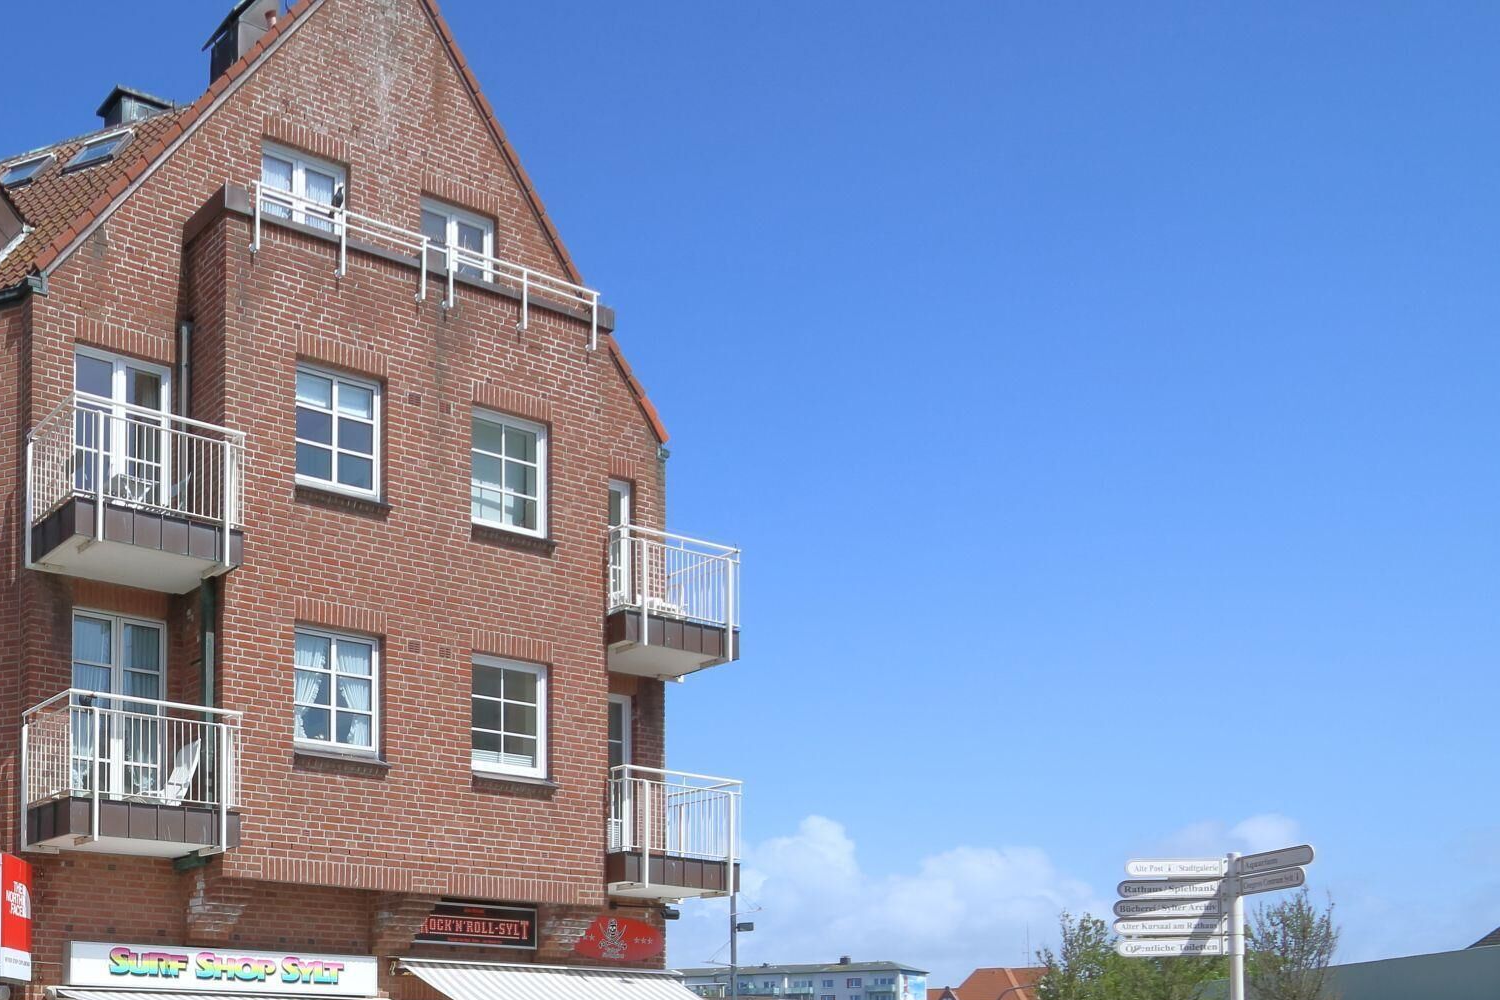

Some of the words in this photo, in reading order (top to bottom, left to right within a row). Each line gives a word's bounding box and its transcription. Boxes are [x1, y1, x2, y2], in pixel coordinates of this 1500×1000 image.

[1133, 864, 1148, 873] Alte
[1149, 864, 1164, 873] Post
[1178, 864, 1219, 874] Stadtgalerie
[1245, 858, 1278, 870] Aquarium
[13, 880, 24, 894] THE
[1123, 885, 1162, 893] Rathaus
[1169, 884, 1216, 894] Spielbank
[5, 889, 24, 906] NORTH
[9, 902, 24, 918] FACE
[1120, 904, 1157, 913] Bücherei
[1162, 904, 1186, 913] Sylter
[1188, 903, 1216, 912] Archiv
[1141, 922, 1171, 930] Kursaal
[1187, 922, 1218, 930] Rathaus
[1180, 943, 1218, 951] Toiletten
[109, 946, 189, 979] SURF
[195, 951, 277, 983] SHOP
[281, 956, 345, 985] SYLT
